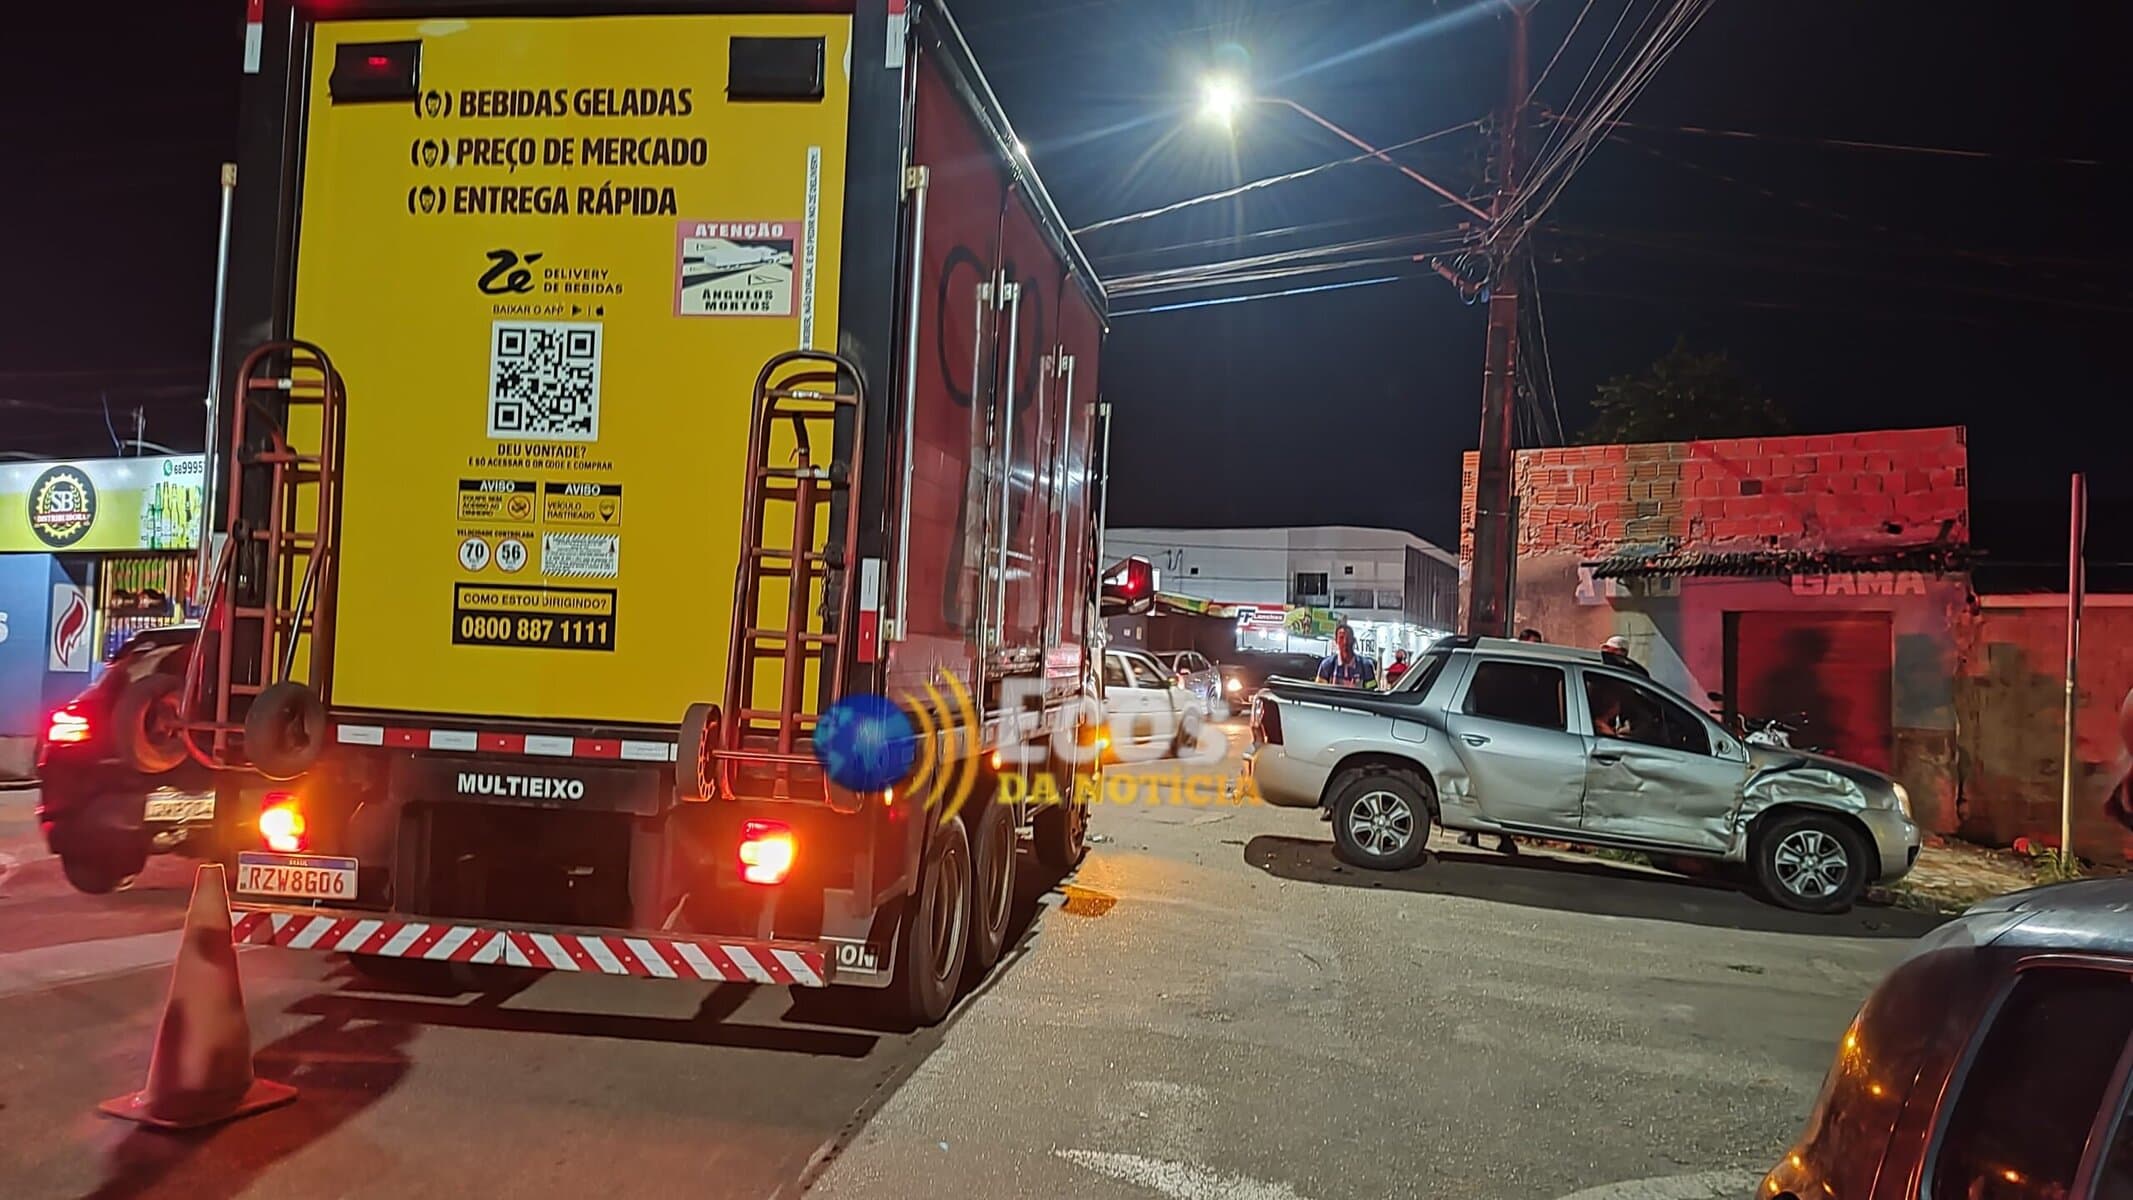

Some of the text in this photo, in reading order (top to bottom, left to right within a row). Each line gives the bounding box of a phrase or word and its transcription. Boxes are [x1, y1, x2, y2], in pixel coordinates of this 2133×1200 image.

[459, 88, 692, 118] BEBIDAS GELADAS
[456, 137, 708, 173] PREÇO DE MERCADO
[453, 180, 678, 216] ENTREGA RÁPIDA
[696, 222, 784, 239] ATENÇÃO
[478, 249, 543, 294] Zé
[544, 268, 609, 280] DELIVERY
[544, 283, 623, 295] DE BEBIDAS
[493, 304, 564, 315] BAIXAR O APP
[705, 301, 770, 311] MORTOS
[498, 443, 587, 459] DEU VONTADE?
[487, 457, 523, 468] ACESSAR
[525, 459, 531, 468] O
[533, 459, 543, 469] QR
[545, 460, 565, 469] CODE
[567, 460, 571, 469] E
[574, 461, 613, 470] COMPRAR
[480, 480, 515, 493] AVISO
[565, 483, 600, 496] AVISO
[51, 491, 74, 512] SB
[547, 511, 595, 519] RASTREADO
[457, 529, 534, 539] VELOCIDADE CONTROLADA
[466, 542, 484, 559] 70
[502, 543, 521, 561] 56
[1791, 572, 1926, 596] GAMA
[464, 593, 607, 611] COMO ESTOU DIRIGINDO?
[461, 615, 608, 644] 0800 887 1111
[457, 772, 584, 800] MULTIEIXO
[249, 867, 344, 894] RZW8G06
